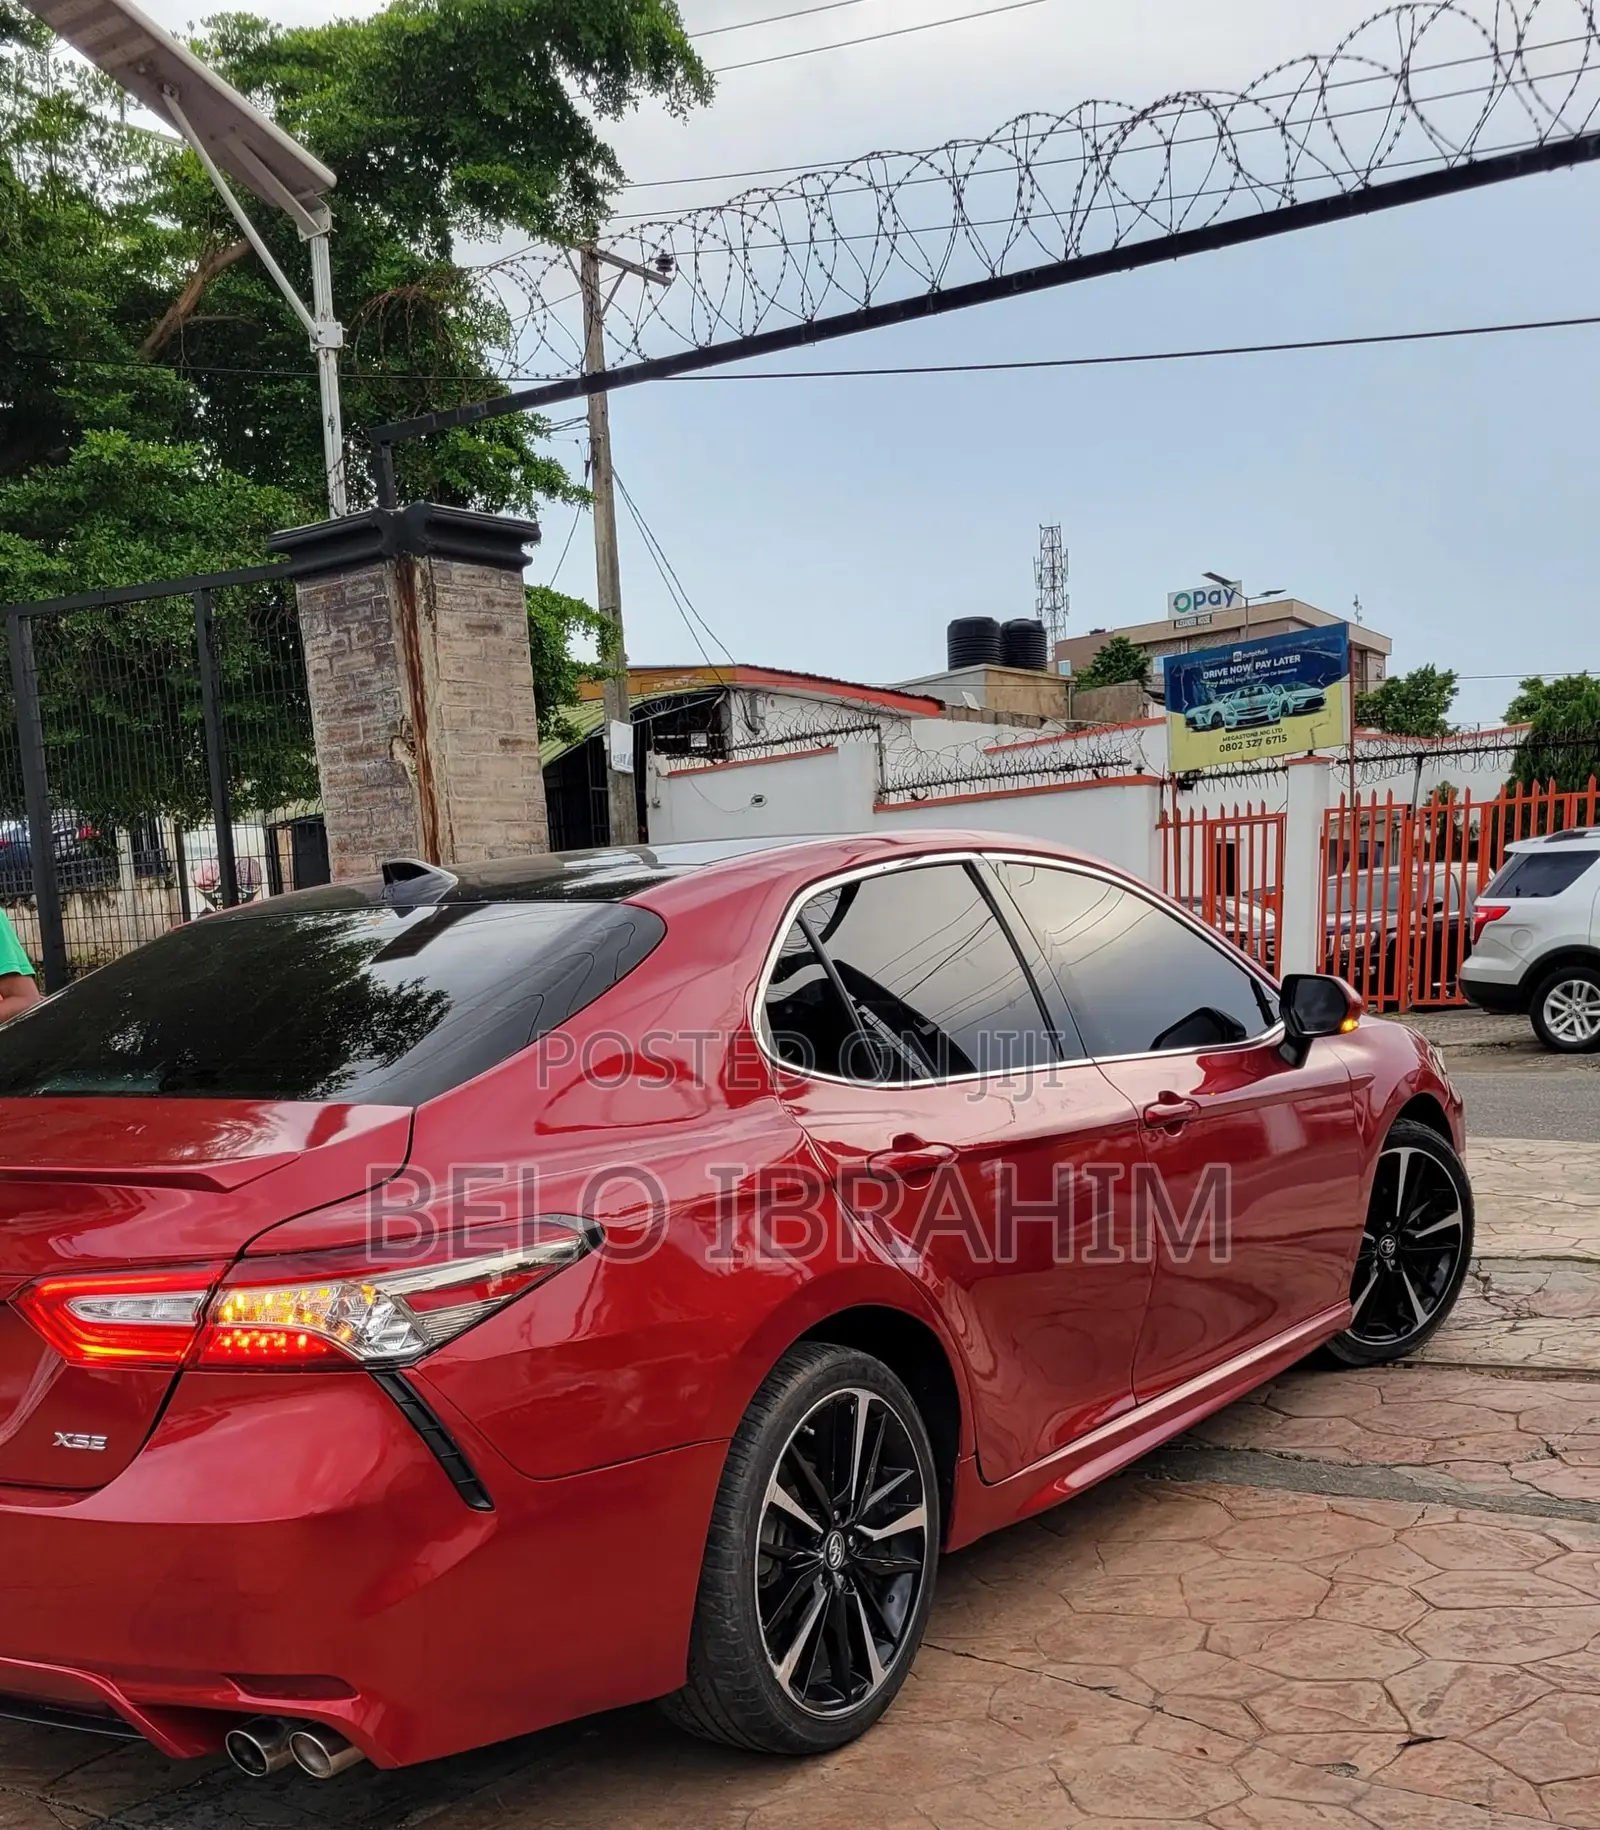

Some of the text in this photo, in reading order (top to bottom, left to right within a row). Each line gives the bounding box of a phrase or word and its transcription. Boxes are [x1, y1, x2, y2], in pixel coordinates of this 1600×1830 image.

[1203, 667, 1228, 679] DRIVE
[1255, 659, 1272, 670] PAY
[1273, 654, 1301, 667] LATER
[1219, 734, 1287, 752] 0802 327 6715
[52, 1432, 108, 1450] XSE
